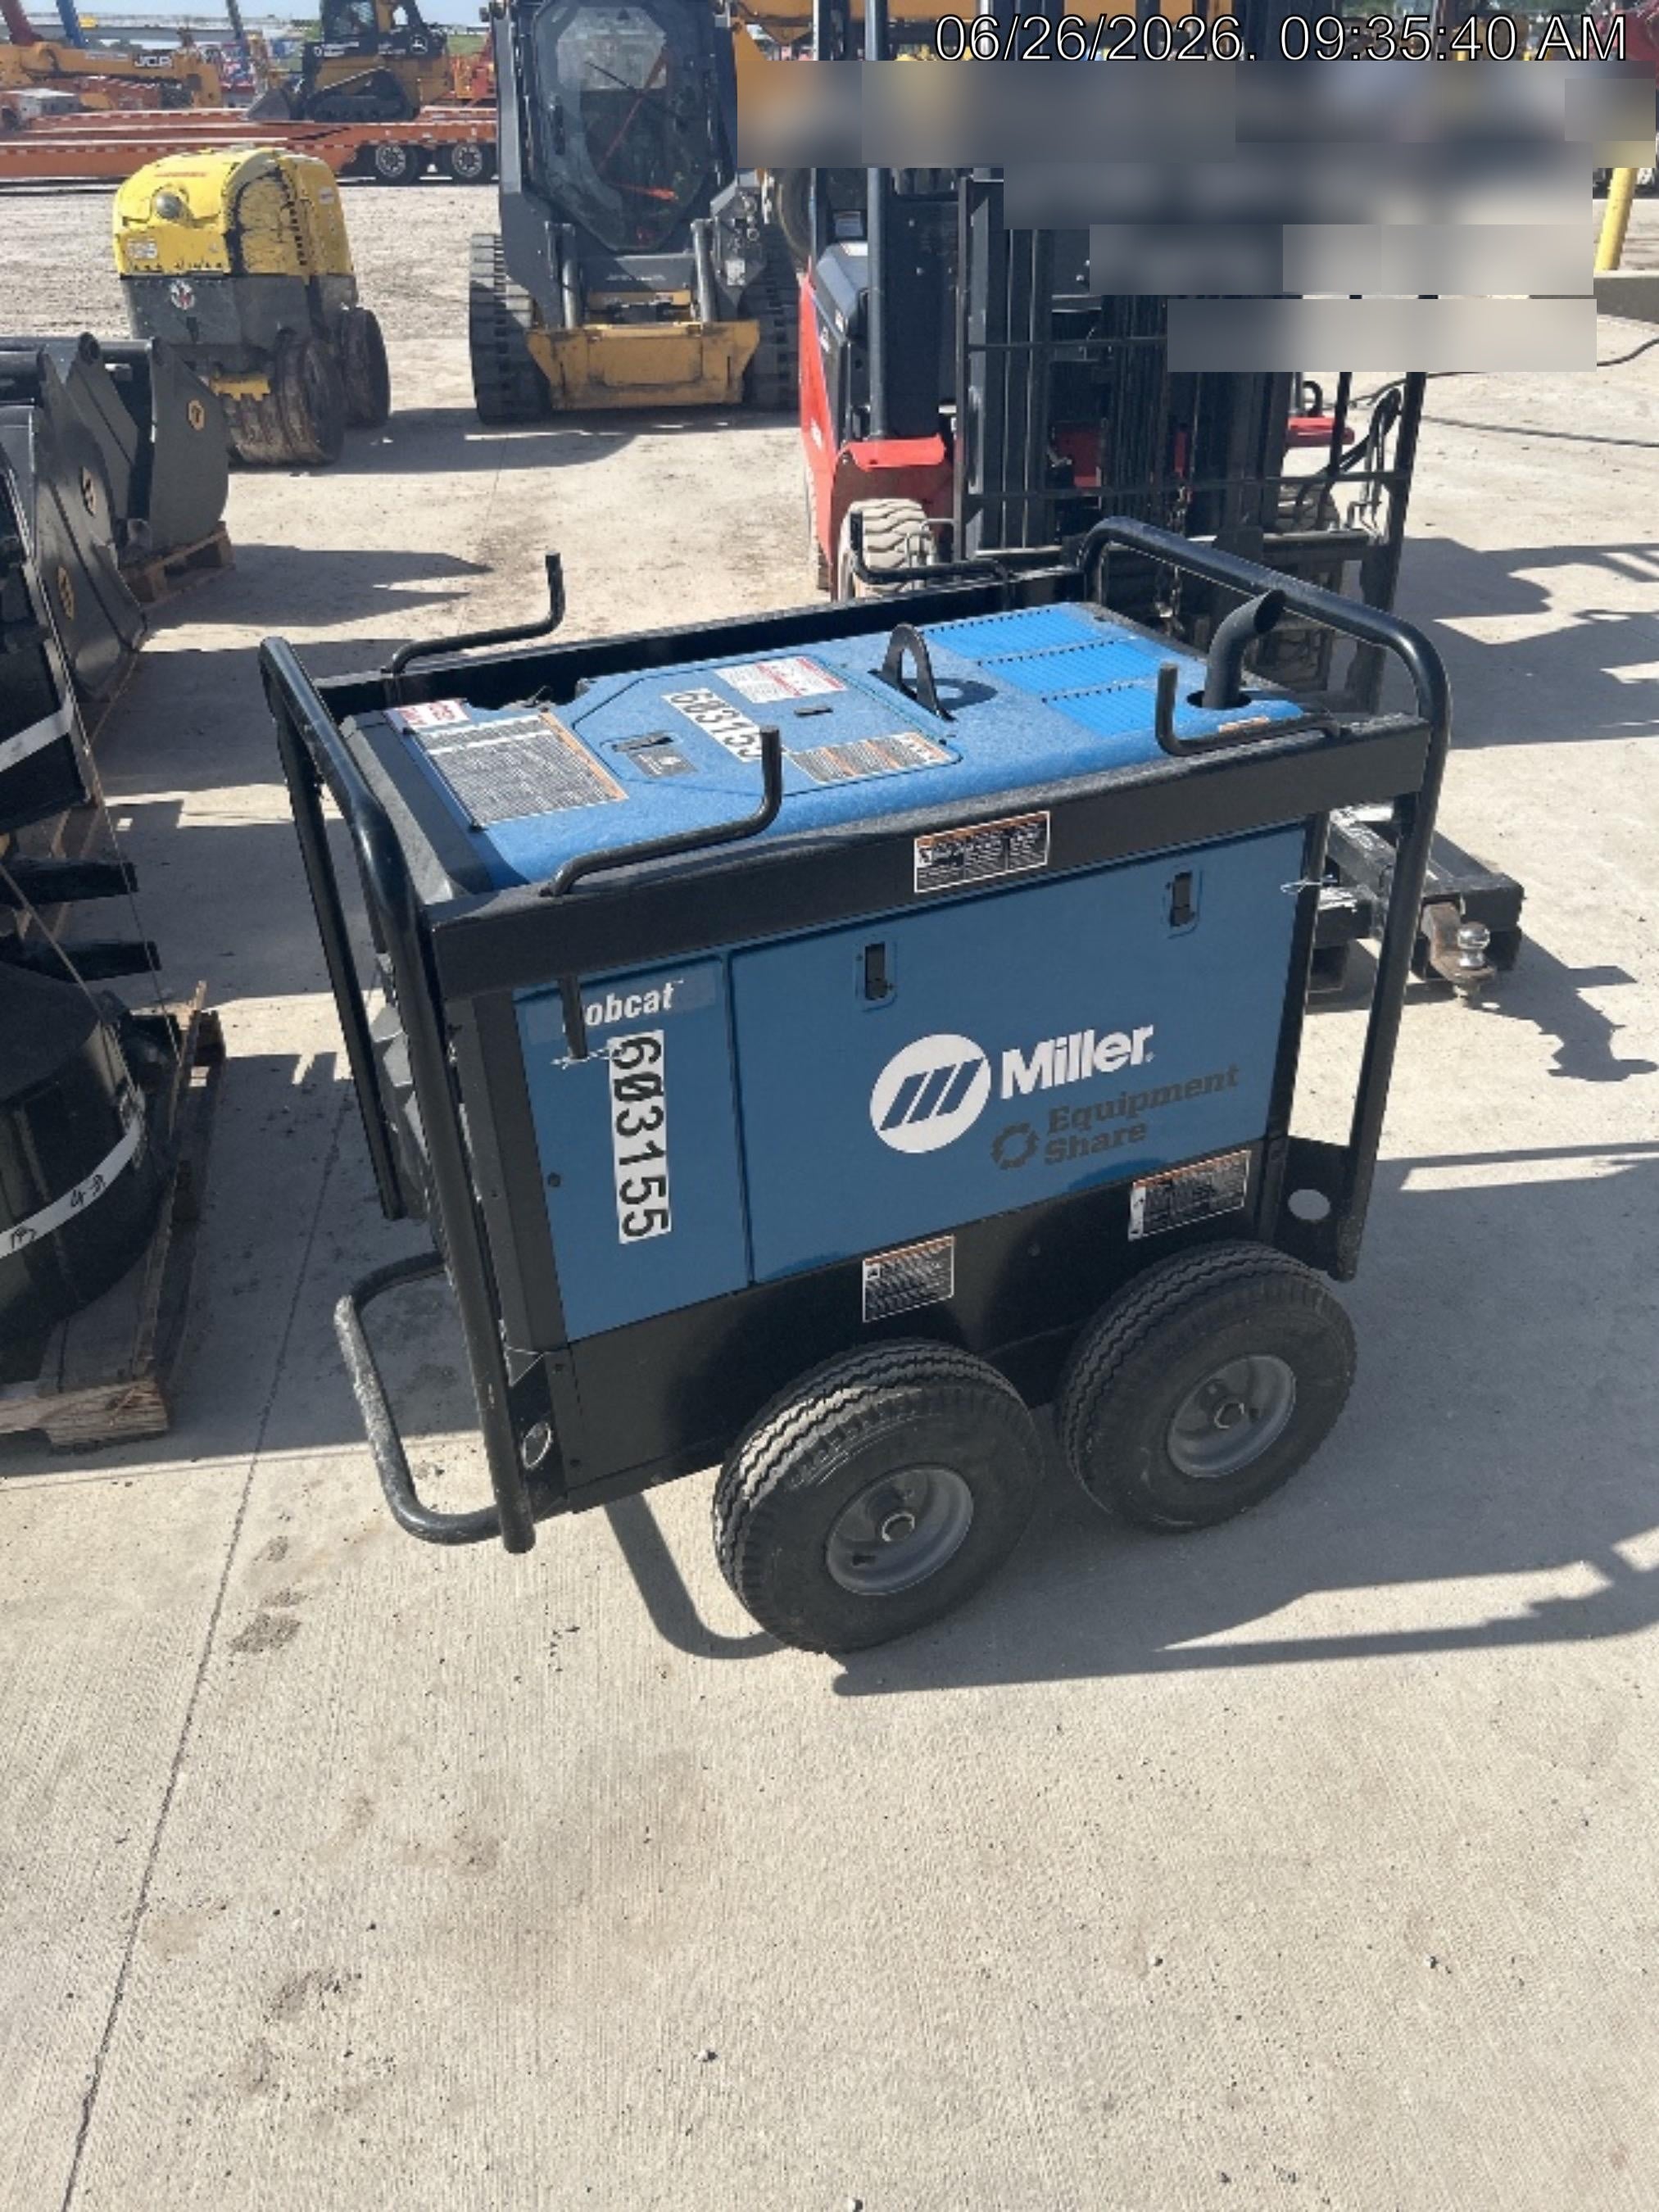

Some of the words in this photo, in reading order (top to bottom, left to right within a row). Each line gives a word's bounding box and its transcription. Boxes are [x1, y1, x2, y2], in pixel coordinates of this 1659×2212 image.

[564, 981, 676, 1030] obcat
[1001, 1024, 1154, 1099] Miller
[1046, 1064, 1240, 1135] Equipment
[611, 1036, 670, 1238] 603155
[1045, 1123, 1145, 1164] Share
